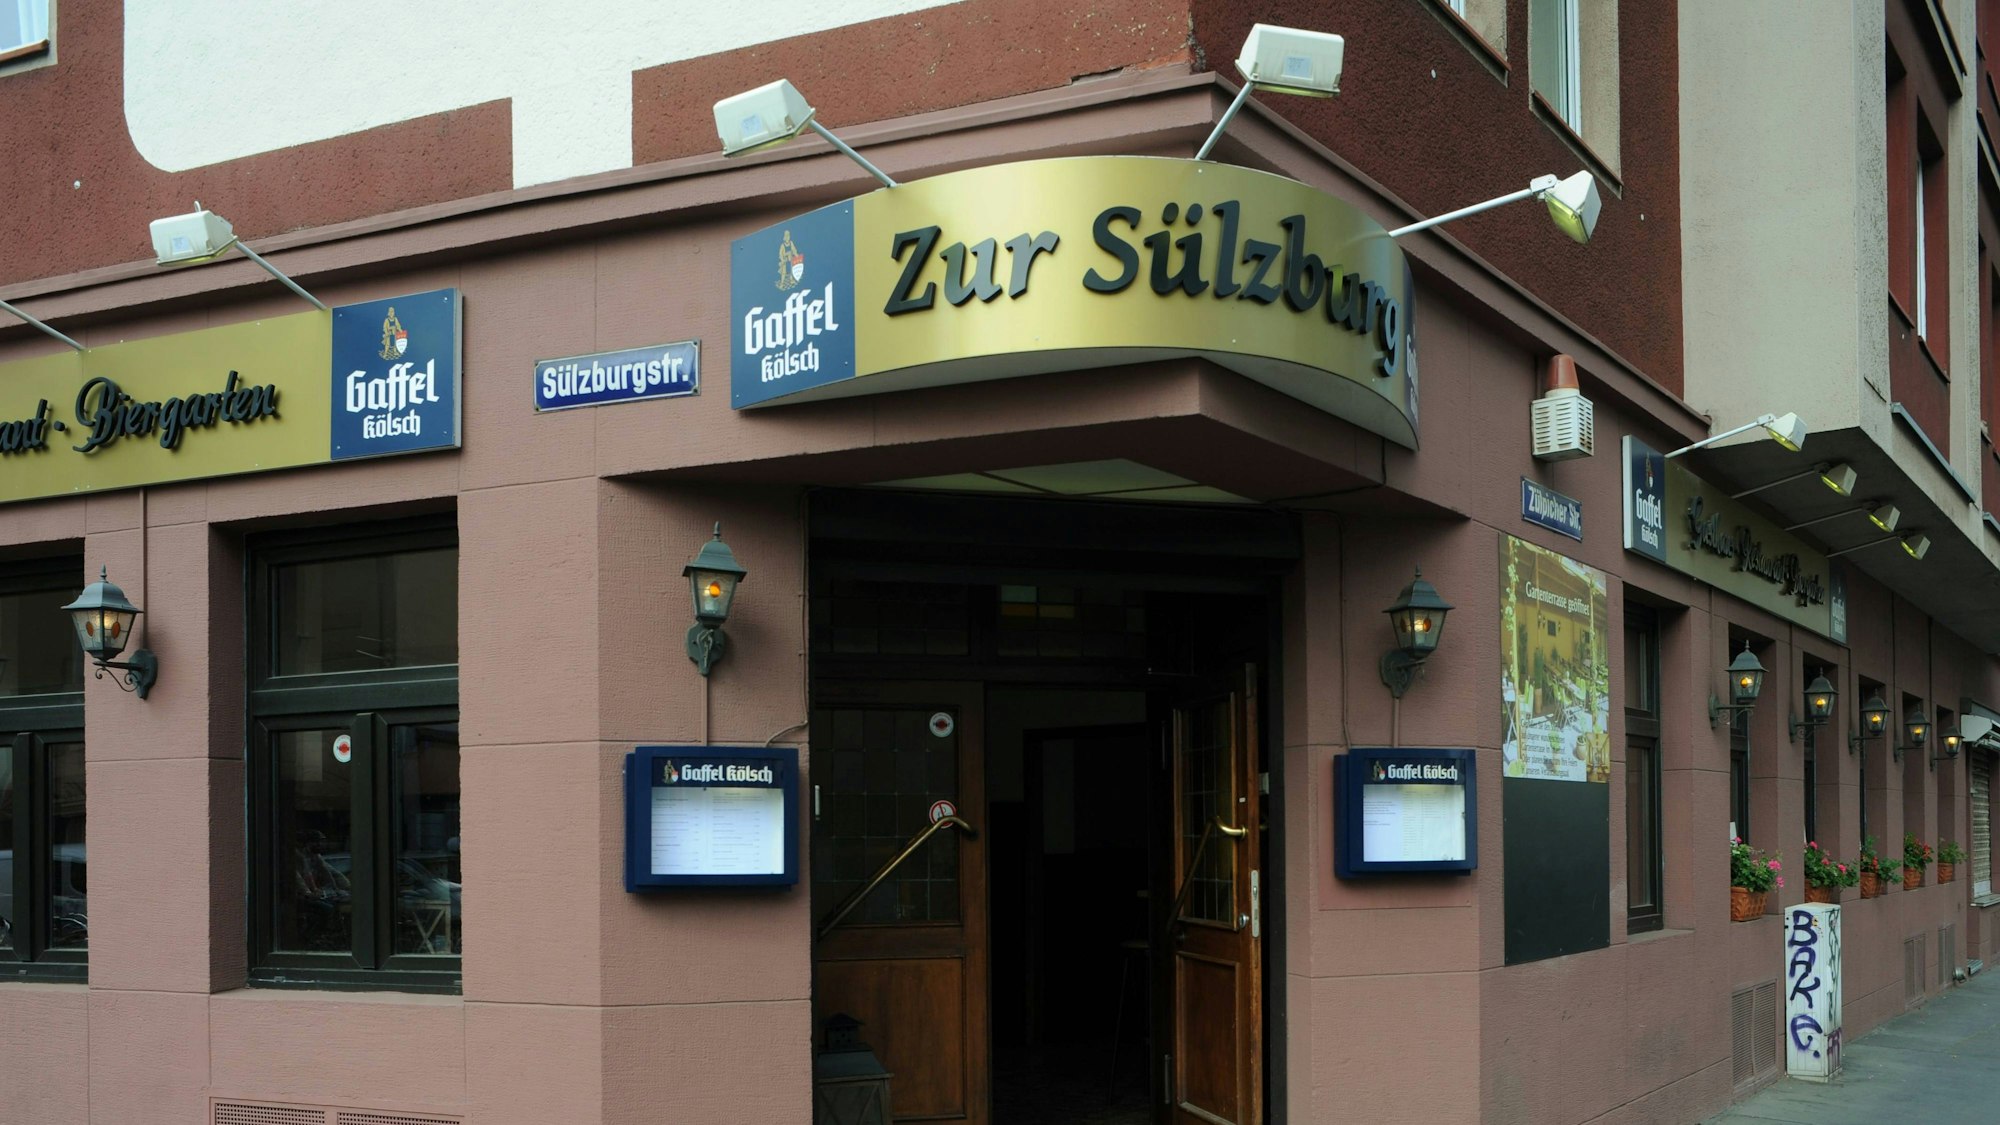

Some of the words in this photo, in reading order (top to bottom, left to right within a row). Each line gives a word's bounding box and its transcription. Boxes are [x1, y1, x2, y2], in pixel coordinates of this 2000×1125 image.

[884, 214, 1060, 317] Zur
[1082, 199, 1401, 377] Sülzburg
[745, 281, 839, 355] Gaffel
[346, 358, 440, 413] Gaffel
[542, 351, 689, 399] Sülzburgstr.
[72, 370, 276, 452] Biergarten
[1528, 485, 1567, 524] Zülpicher
[1568, 502, 1581, 531] Str.
[1635, 488, 1662, 530] Gaffel
[1525, 581, 1567, 609] Gartenterrasse
[681, 764, 724, 782] Gaffel
[1387, 764, 1422, 780] Gaffel
